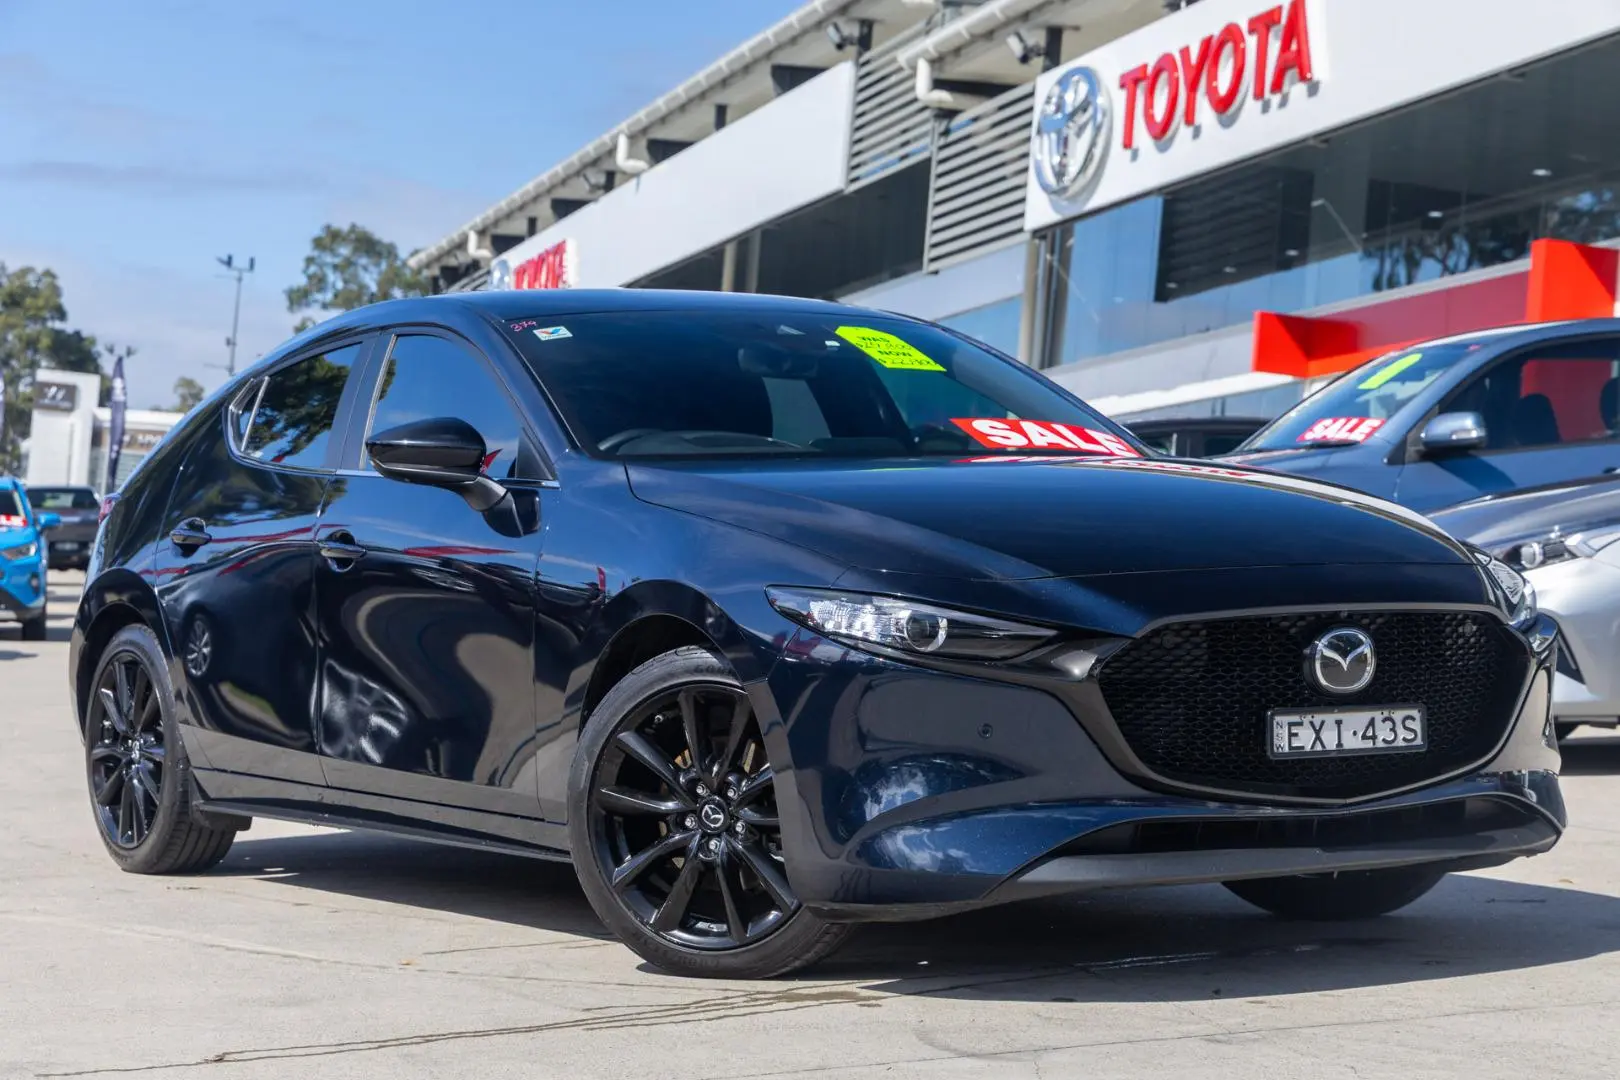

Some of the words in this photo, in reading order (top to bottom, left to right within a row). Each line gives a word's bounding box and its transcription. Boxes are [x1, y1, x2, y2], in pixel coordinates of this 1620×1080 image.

[1119, 0, 1312, 149] TOYOTA
[971, 419, 1138, 458] SALE
[1304, 418, 1382, 441] SALE
